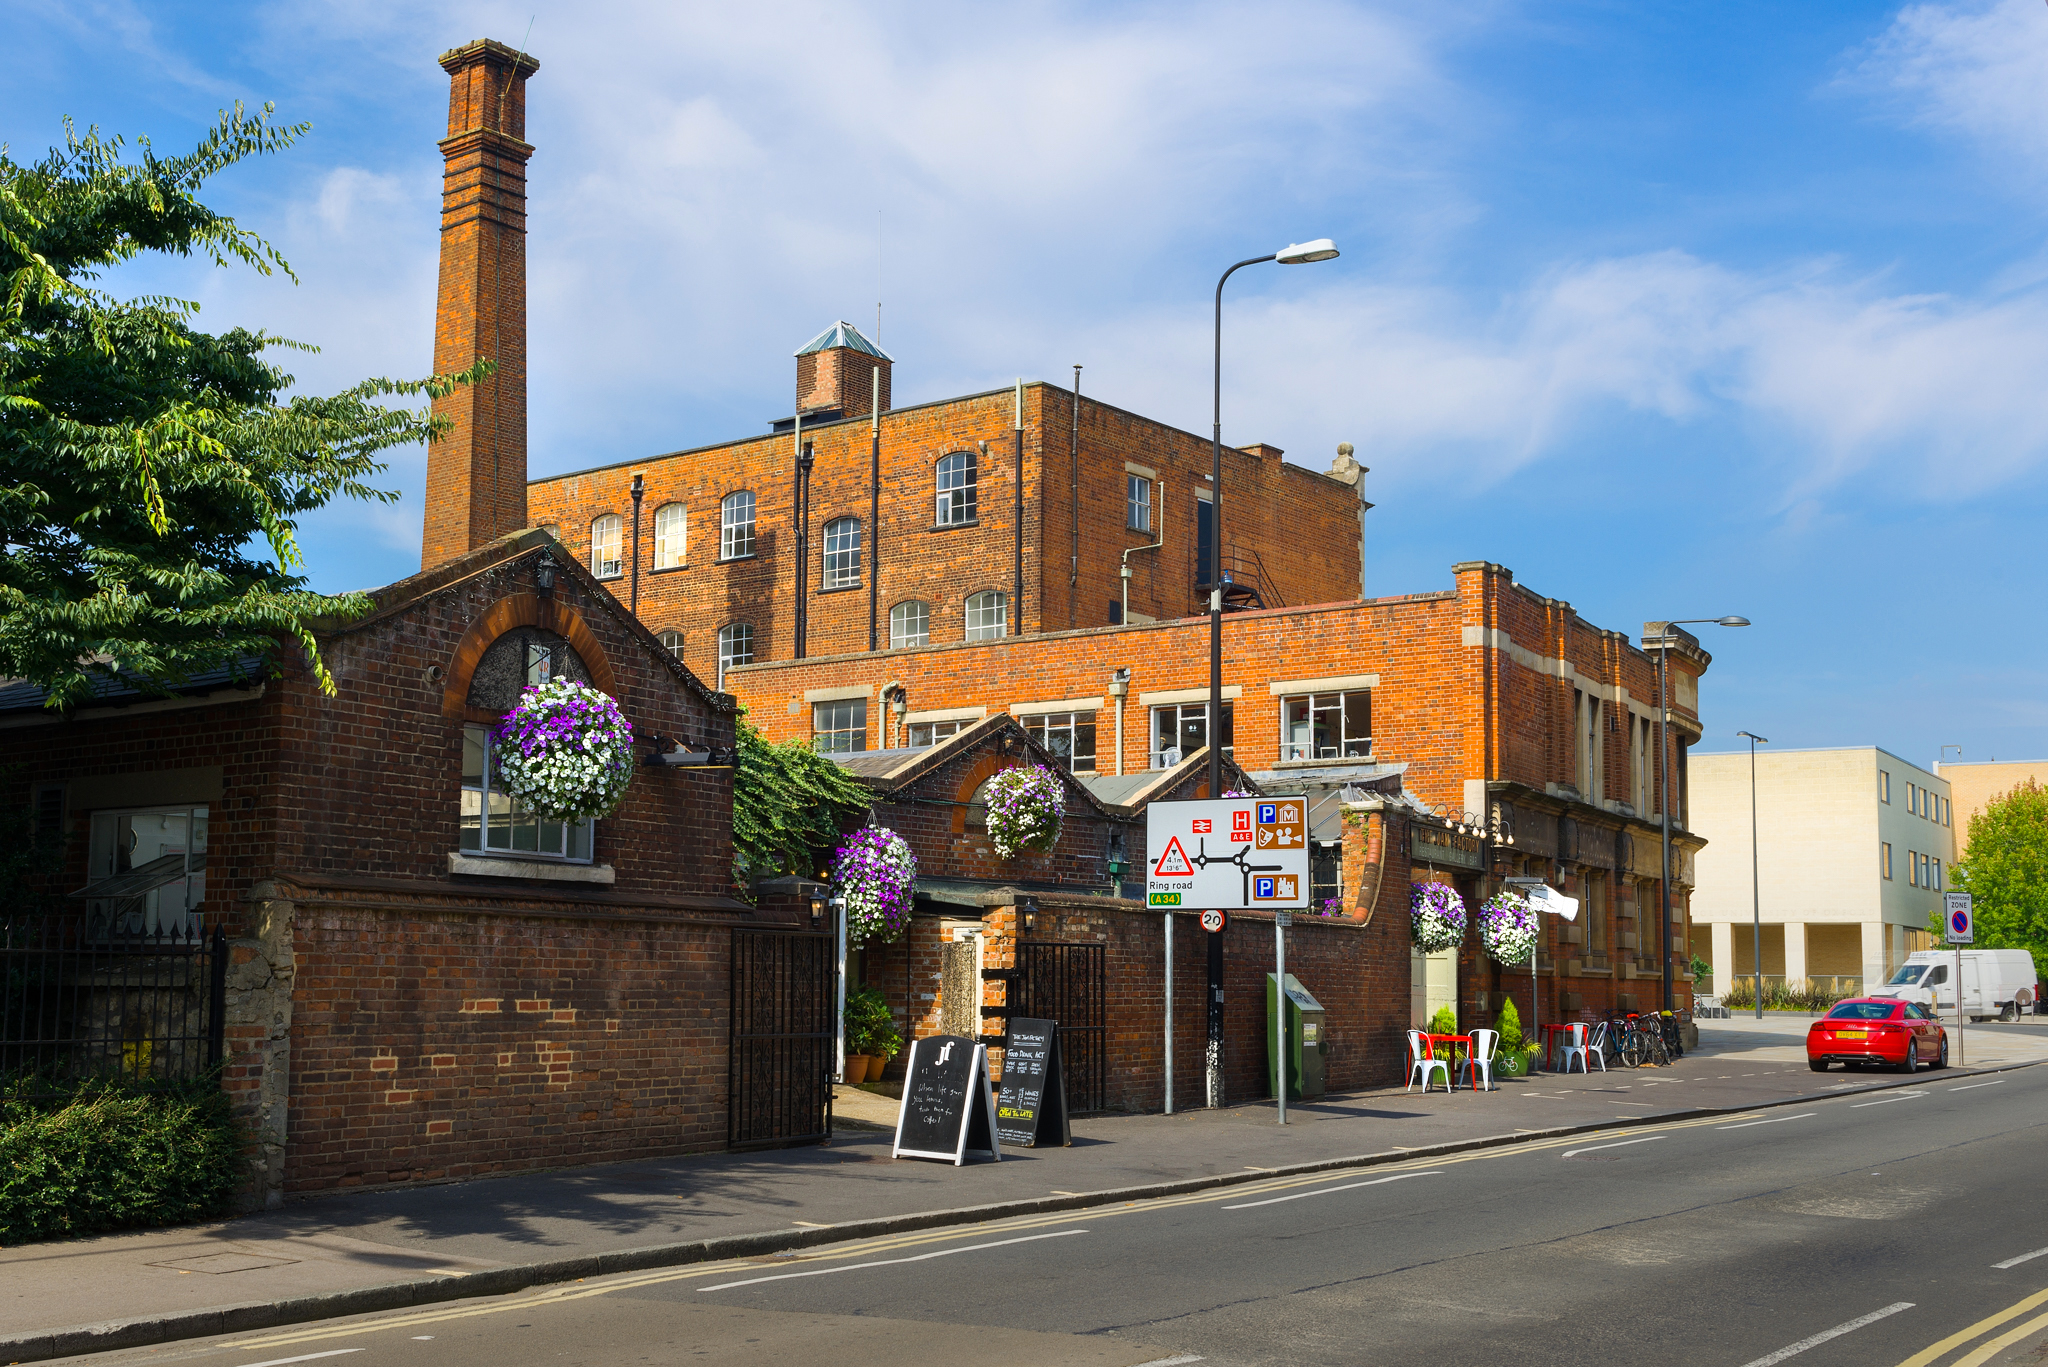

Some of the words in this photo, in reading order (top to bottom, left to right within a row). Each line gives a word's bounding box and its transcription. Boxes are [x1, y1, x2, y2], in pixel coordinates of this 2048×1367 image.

[1236, 813, 1247, 828] H
[1262, 807, 1273, 822] P
[1420, 828, 1432, 844] THE
[1436, 832, 1450, 847] JAM
[1453, 835, 1480, 853] FACTORY
[1469, 856, 1478, 866] BAR
[1150, 882, 1170, 891] Ring
[1172, 882, 1192, 890] road
[1260, 880, 1272, 895] P
[1150, 894, 1180, 904] (A34)
[1204, 914, 1221, 926] 20
[1008, 1048, 1019, 1058] FOOD
